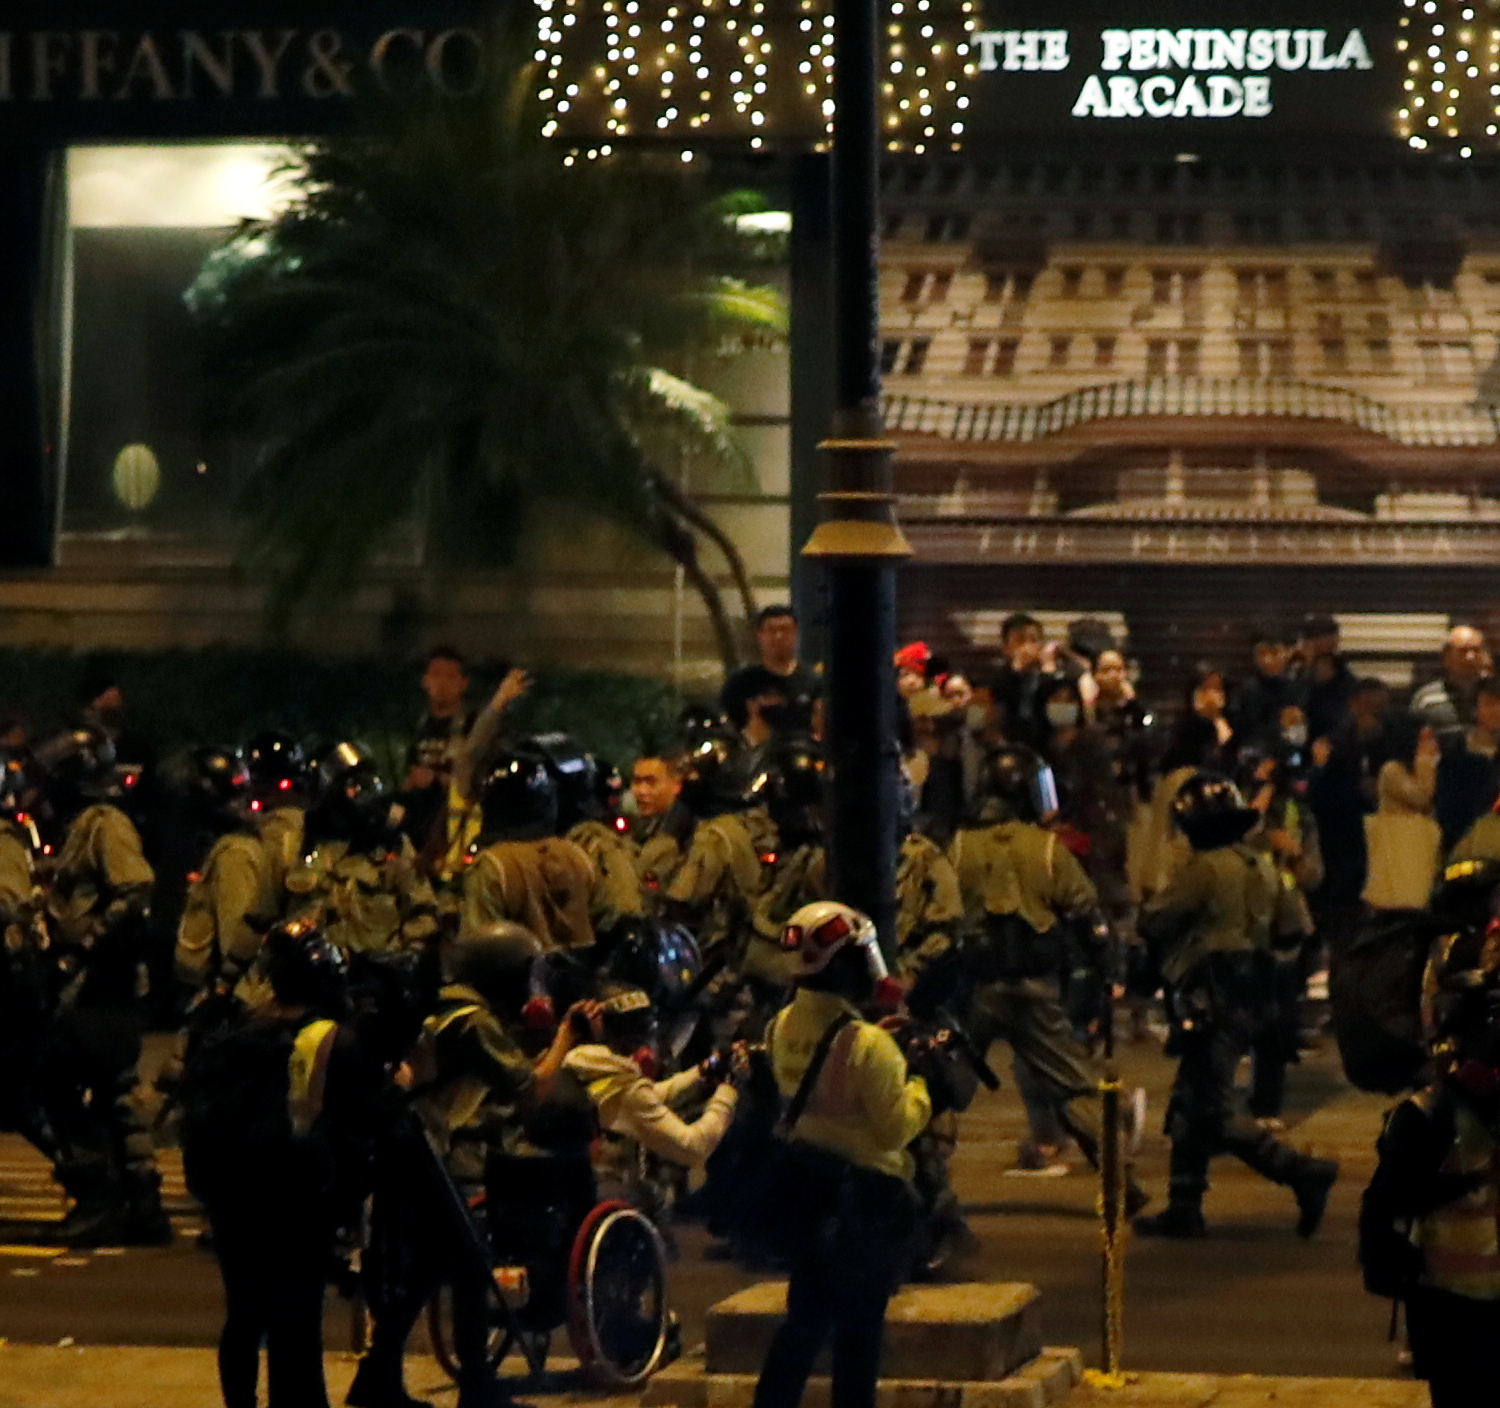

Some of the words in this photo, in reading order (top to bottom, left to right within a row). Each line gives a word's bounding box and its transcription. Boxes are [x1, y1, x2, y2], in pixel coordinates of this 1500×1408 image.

[971, 29, 1070, 71] THE
[1100, 28, 1373, 71] PENINSULA
[1071, 75, 1273, 117] ARCADE
[978, 526, 1074, 556] THE
[1130, 528, 1453, 557] PENINSULA
